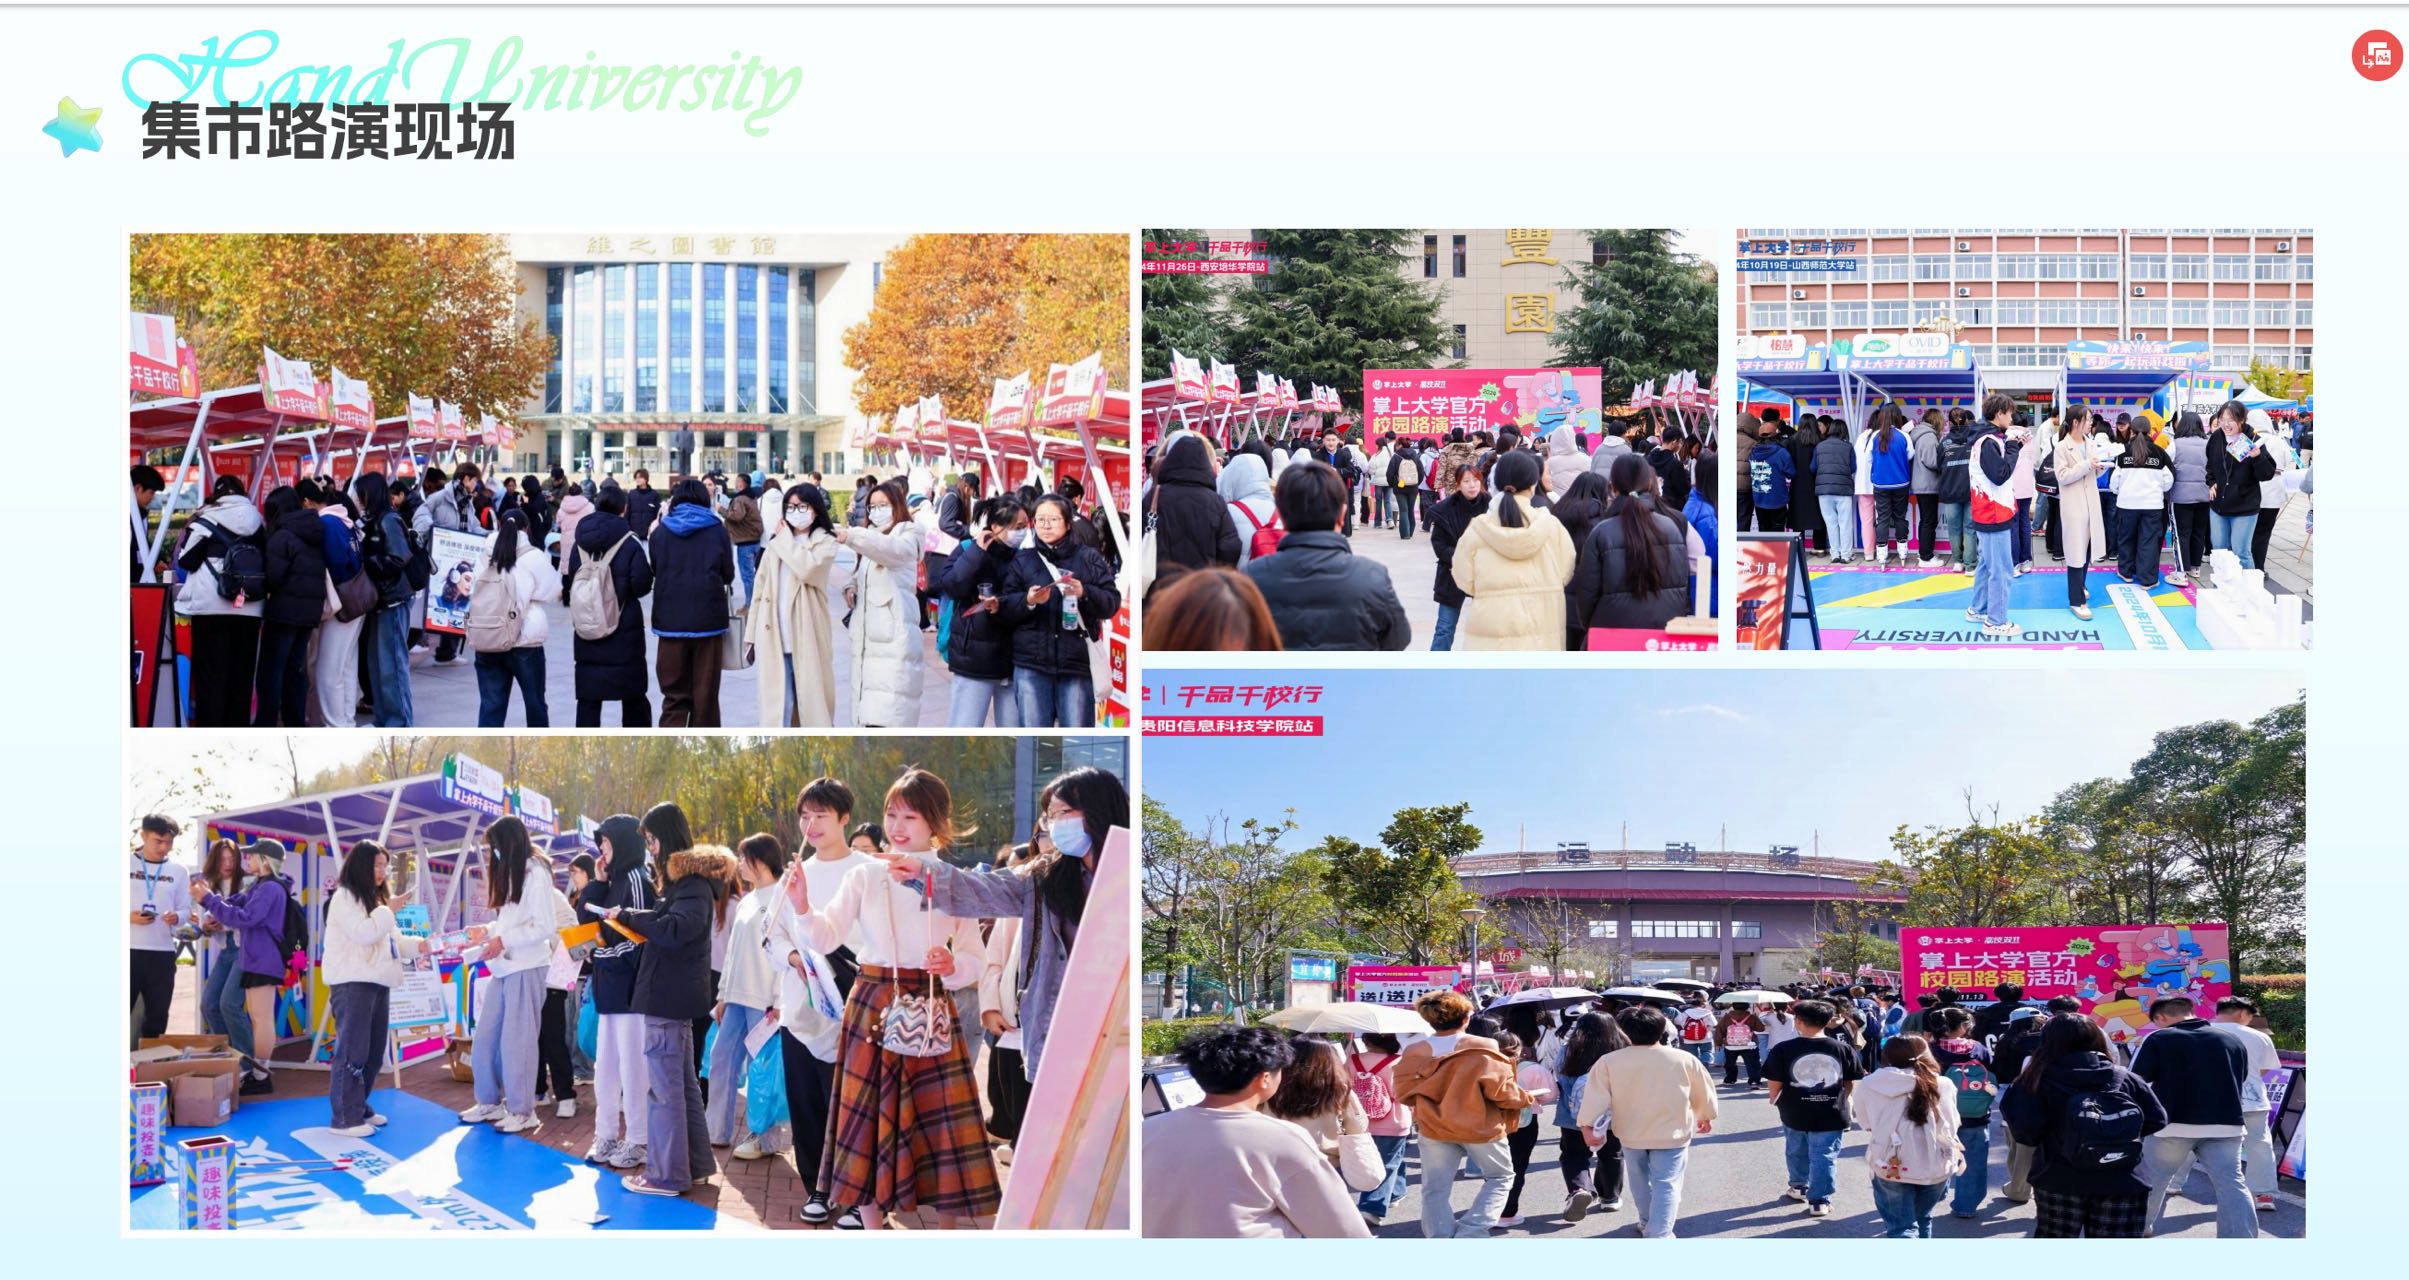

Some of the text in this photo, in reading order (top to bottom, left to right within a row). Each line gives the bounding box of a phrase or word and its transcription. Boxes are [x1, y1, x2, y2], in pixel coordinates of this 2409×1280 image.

[1372, 397, 1487, 415] 掌上大学官方
[1372, 416, 1488, 434] 校园路演活动
[2022, 629, 2101, 642] HAND
[1918, 951, 2077, 970] 掌上大学官方
[1919, 969, 2078, 989] 校园路演活动
